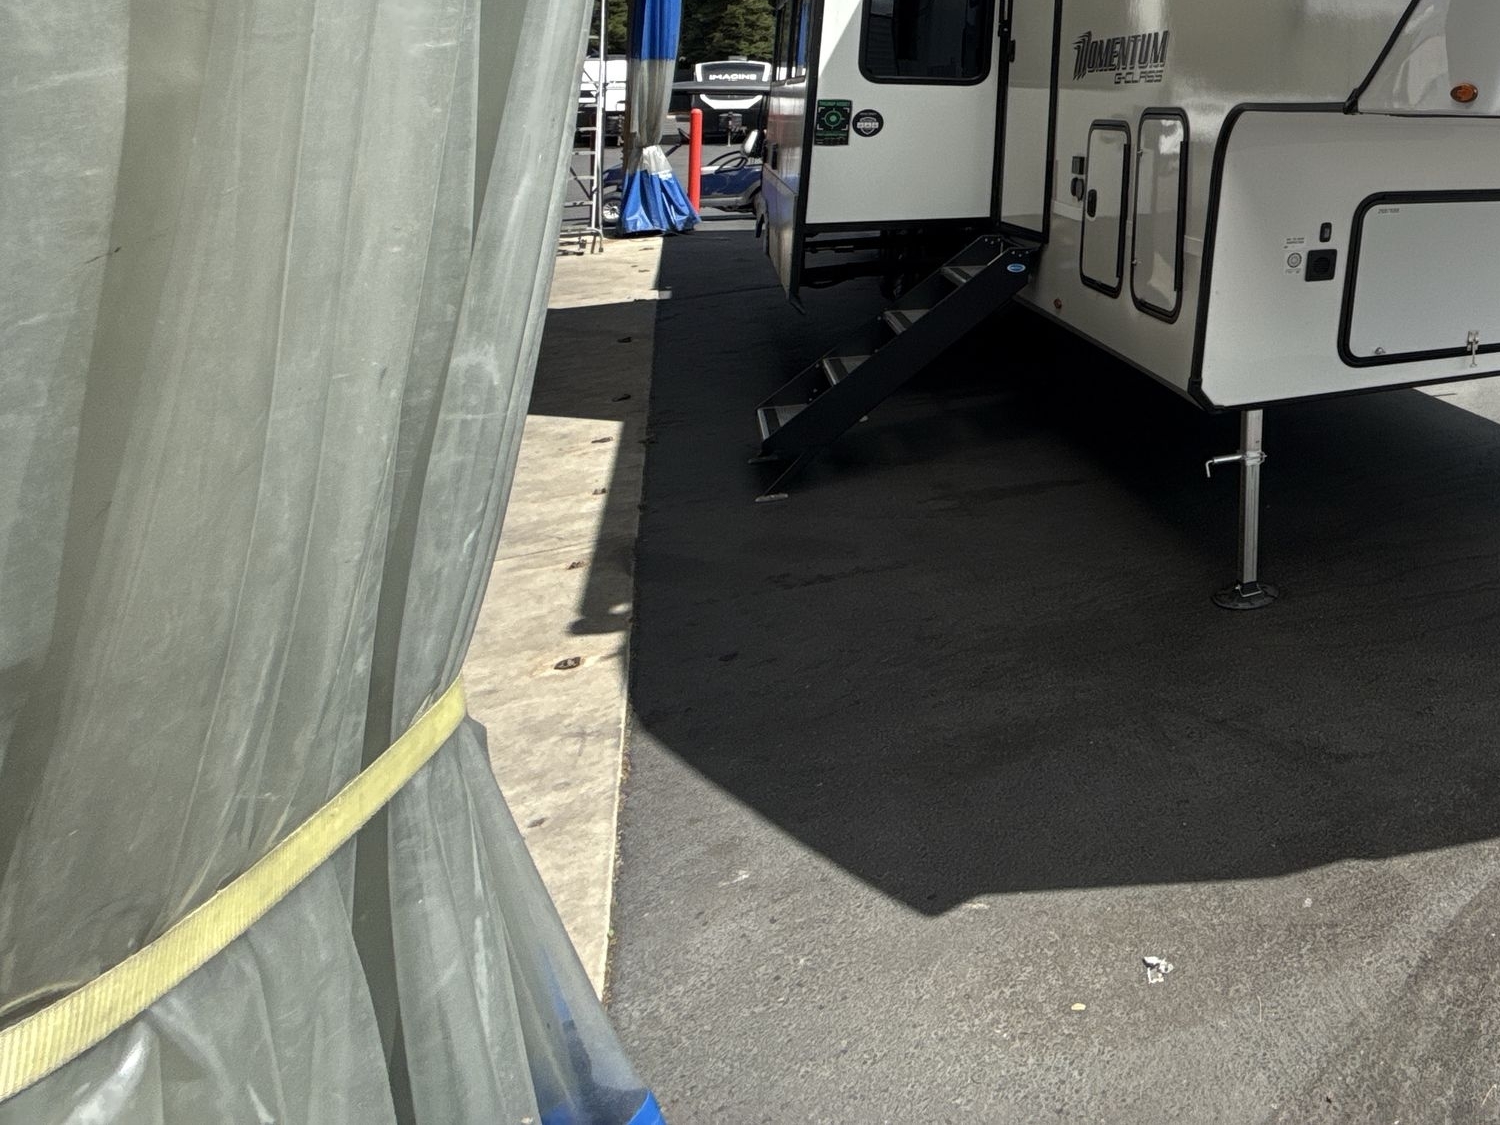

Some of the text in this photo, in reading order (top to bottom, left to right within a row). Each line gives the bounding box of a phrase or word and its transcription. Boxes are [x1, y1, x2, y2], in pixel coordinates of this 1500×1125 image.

[1072, 30, 1170, 81] MOMENTUM
[708, 73, 758, 81] IMAGINE
[1114, 70, 1164, 84] G-CLASS
